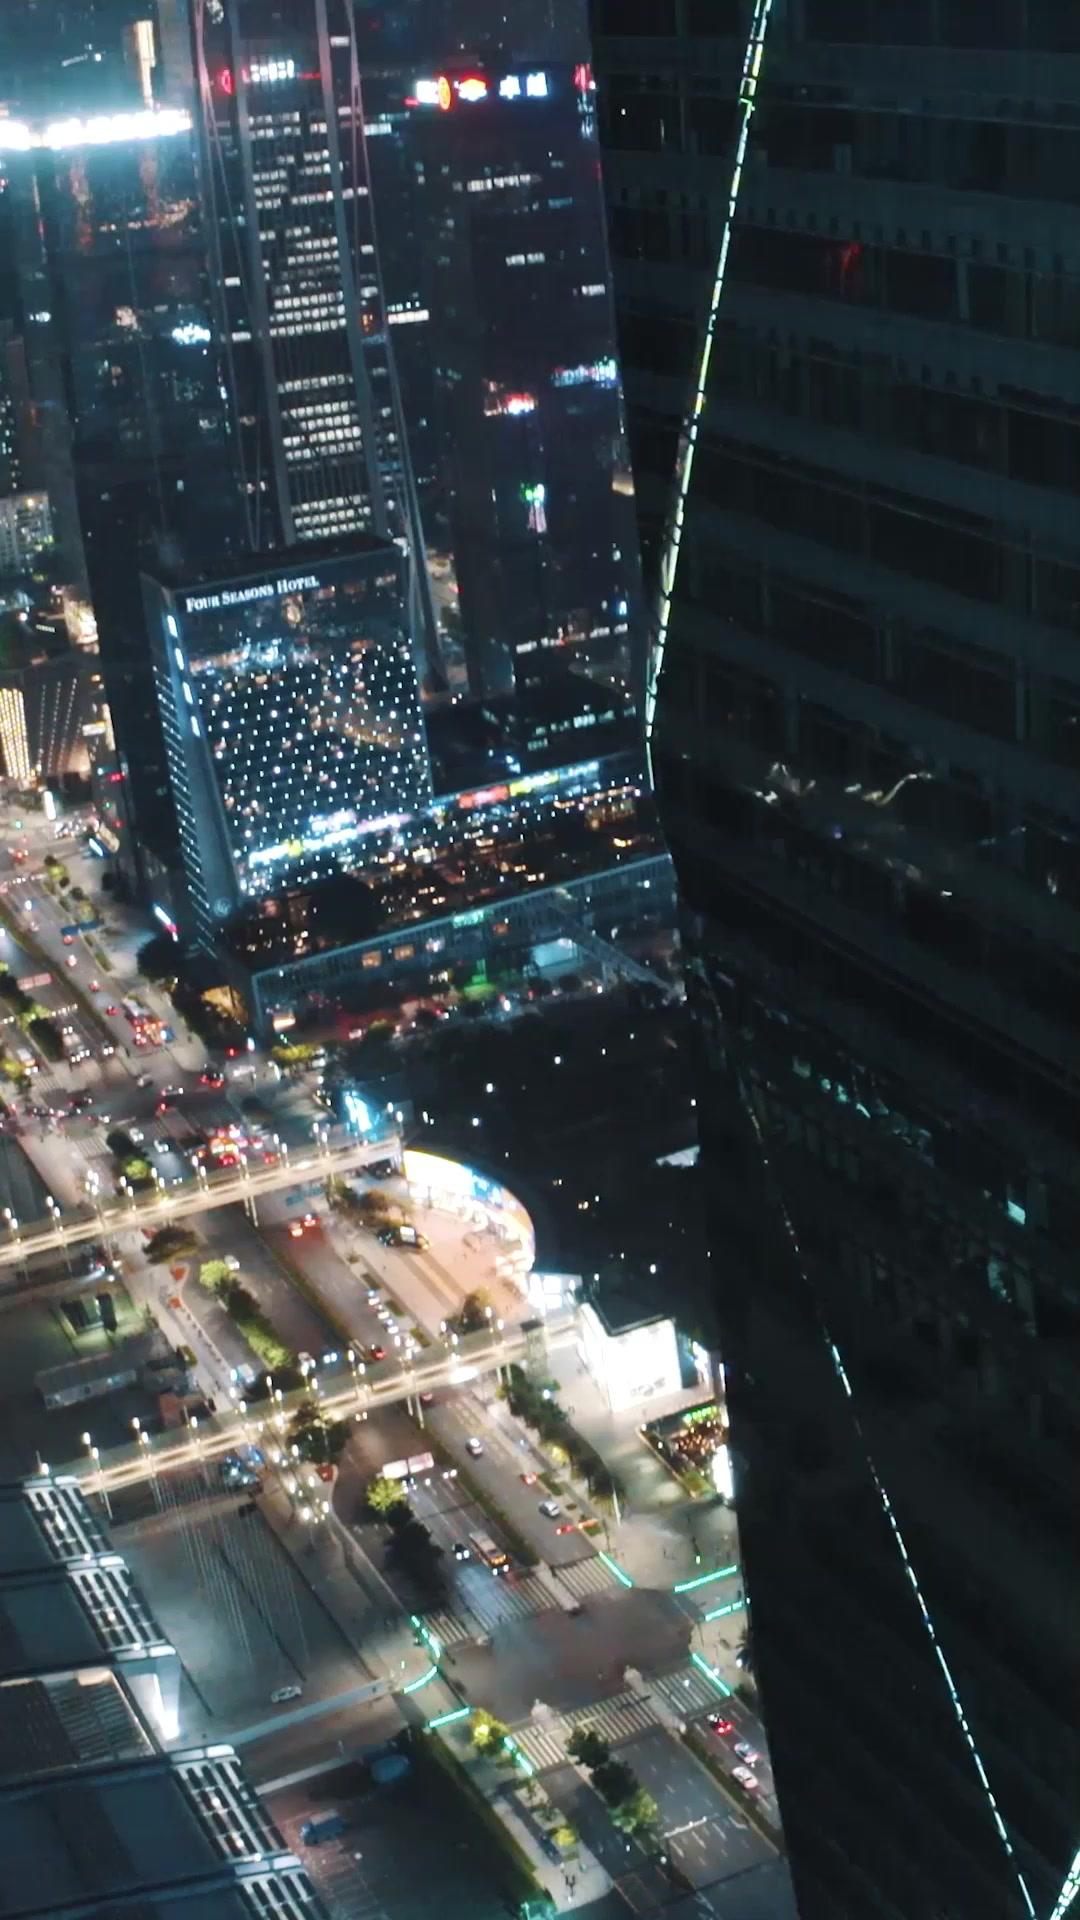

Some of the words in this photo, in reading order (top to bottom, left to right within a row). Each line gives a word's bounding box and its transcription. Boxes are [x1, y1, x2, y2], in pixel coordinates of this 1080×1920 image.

[185, 595, 220, 613] FOUR
[221, 584, 274, 605] SEASONS
[276, 575, 320, 594] HOTEL
